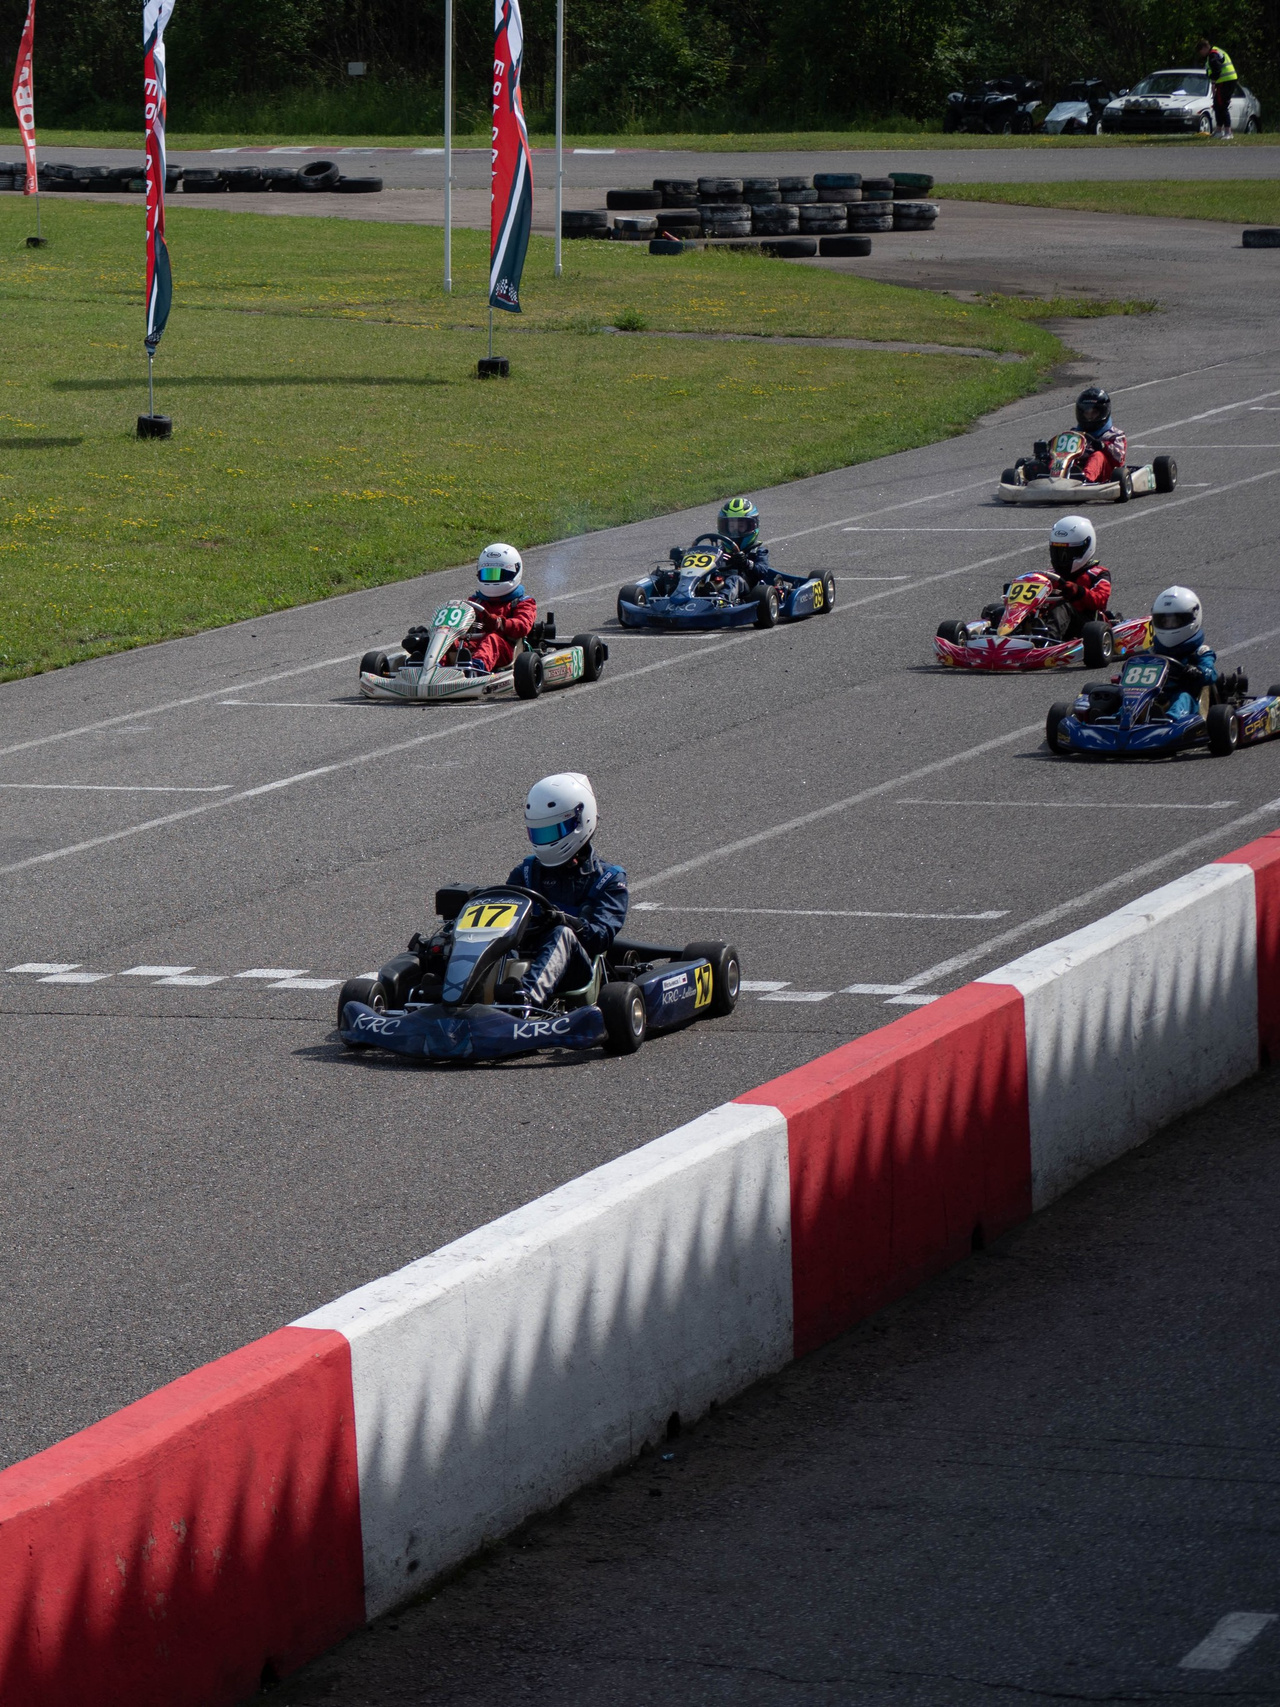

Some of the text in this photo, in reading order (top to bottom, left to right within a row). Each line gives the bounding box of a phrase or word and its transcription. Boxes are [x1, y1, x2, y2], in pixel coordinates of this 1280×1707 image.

[1056, 435, 1079, 453] 96
[682, 555, 713, 568] 69
[813, 582, 823, 608] 69
[1009, 584, 1040, 600] 95
[434, 608, 463, 626] 89
[572, 649, 583, 678] 89
[1125, 667, 1158, 684] 85
[467, 905, 512, 928] 17
[697, 965, 711, 1005] 17
[353, 1012, 401, 1036] KRC
[513, 1018, 570, 1040] KRC
